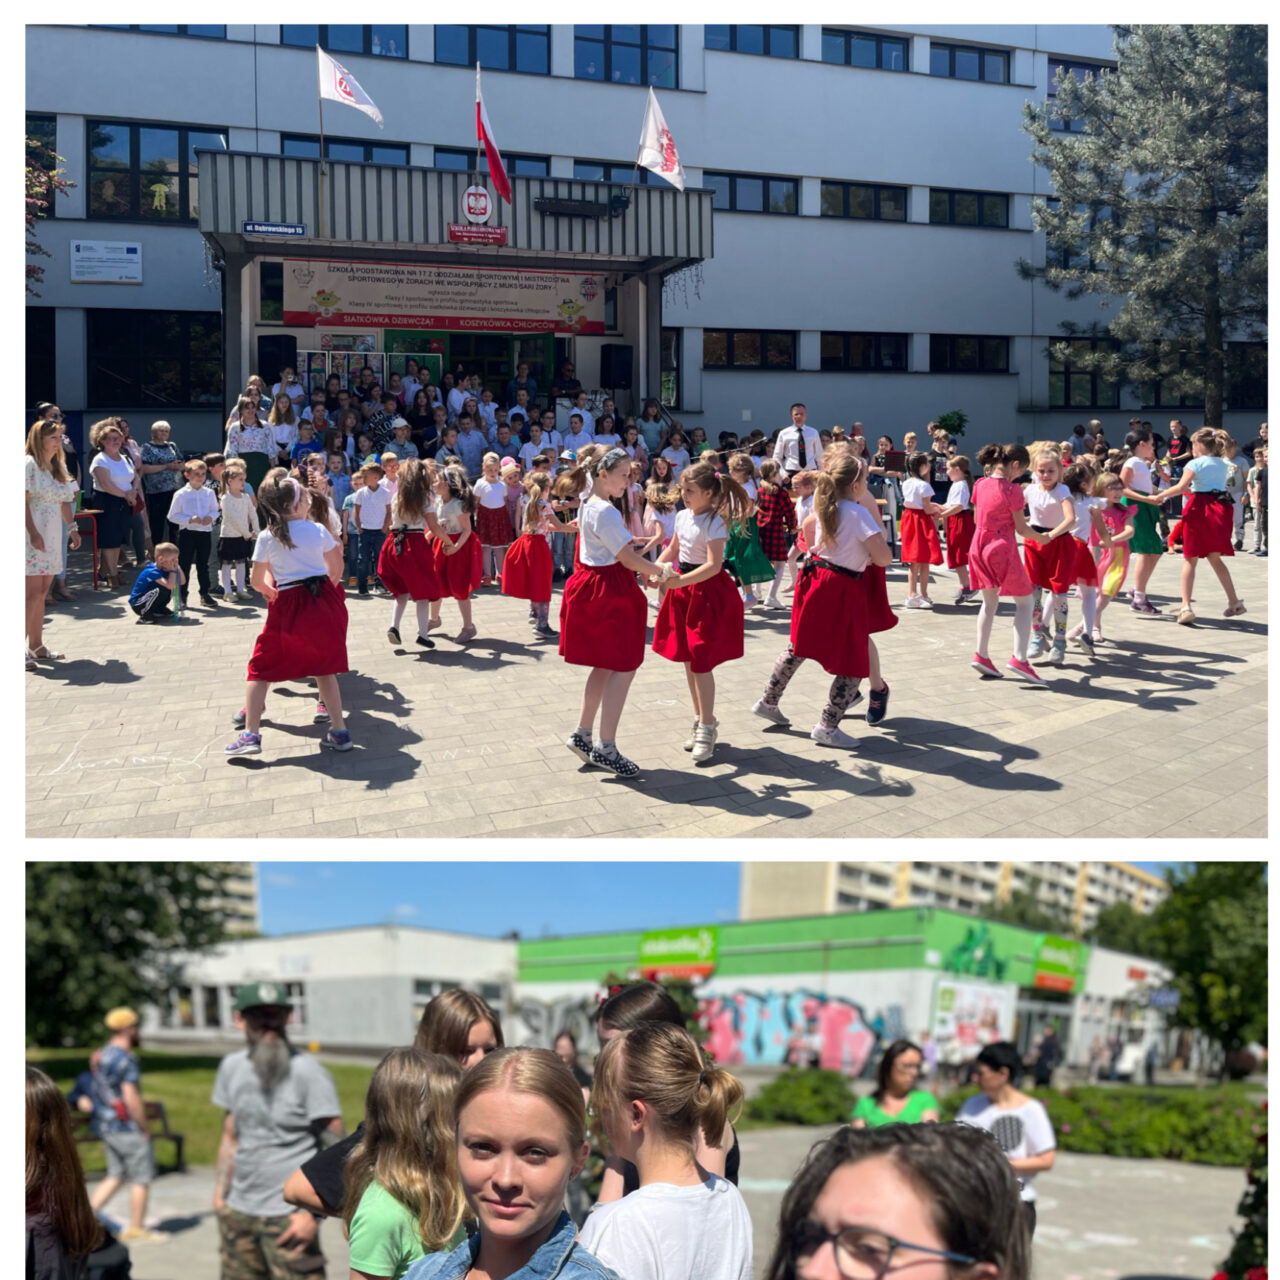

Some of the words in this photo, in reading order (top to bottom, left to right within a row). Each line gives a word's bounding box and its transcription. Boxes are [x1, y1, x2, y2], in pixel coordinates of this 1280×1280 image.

[348, 275, 397, 284] SPORTOWEGO
[356, 267, 406, 275] PODSTAWOWA
[434, 271, 474, 279] ODDZIAŁAMI
[524, 276, 570, 284] MISTRZOSTWA
[343, 315, 390, 324] SIATKÓWKA
[392, 317, 435, 326] DZIEWCZĄT
[460, 319, 512, 328] KOSZYKÓWKA
[513, 319, 555, 329] CHŁOPCÓW
